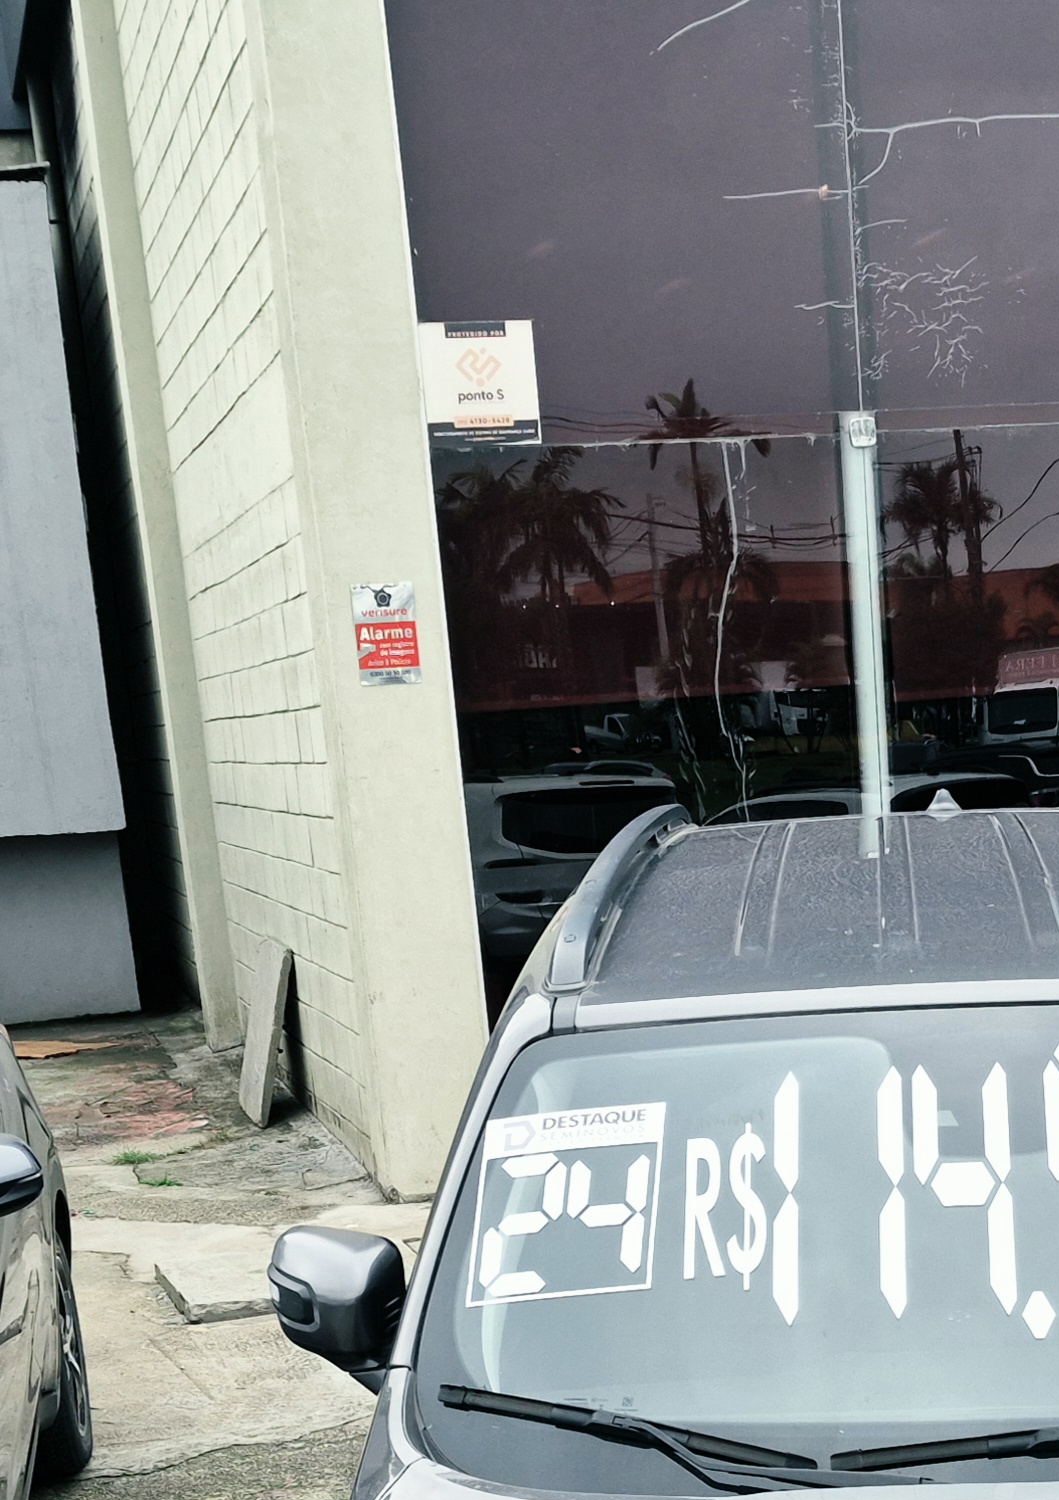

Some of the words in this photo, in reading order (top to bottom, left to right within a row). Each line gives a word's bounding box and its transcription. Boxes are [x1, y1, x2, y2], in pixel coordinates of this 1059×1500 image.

[458, 391, 494, 405] ponto
[496, 388, 505, 400] S
[361, 608, 408, 618] verisure
[359, 627, 414, 641] Alarme
[542, 1109, 647, 1131] DESTAQUE
[478, 1152, 651, 1298] 24
